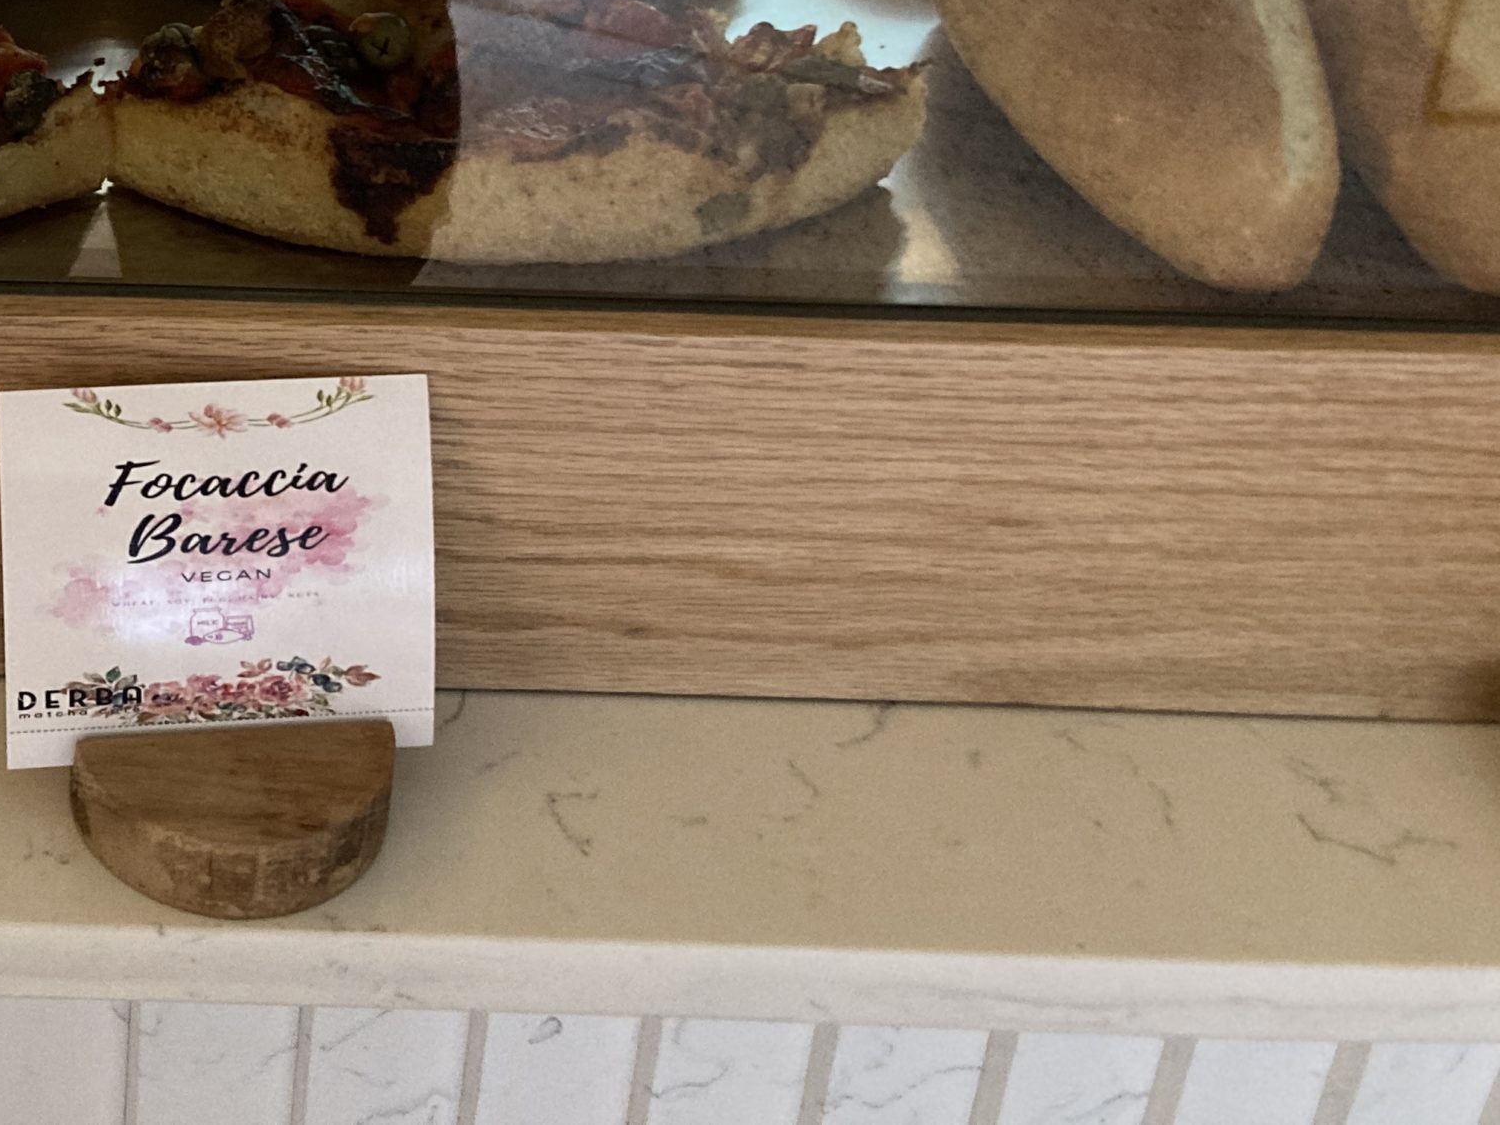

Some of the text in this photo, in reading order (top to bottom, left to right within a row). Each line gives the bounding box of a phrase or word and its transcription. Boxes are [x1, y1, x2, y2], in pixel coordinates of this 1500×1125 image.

[103, 459, 349, 507] Focaccia
[126, 513, 331, 564] Barese
[181, 568, 272, 583] VEGAN
[17, 686, 142, 711] DERBA
[18, 708, 88, 720] matcha
